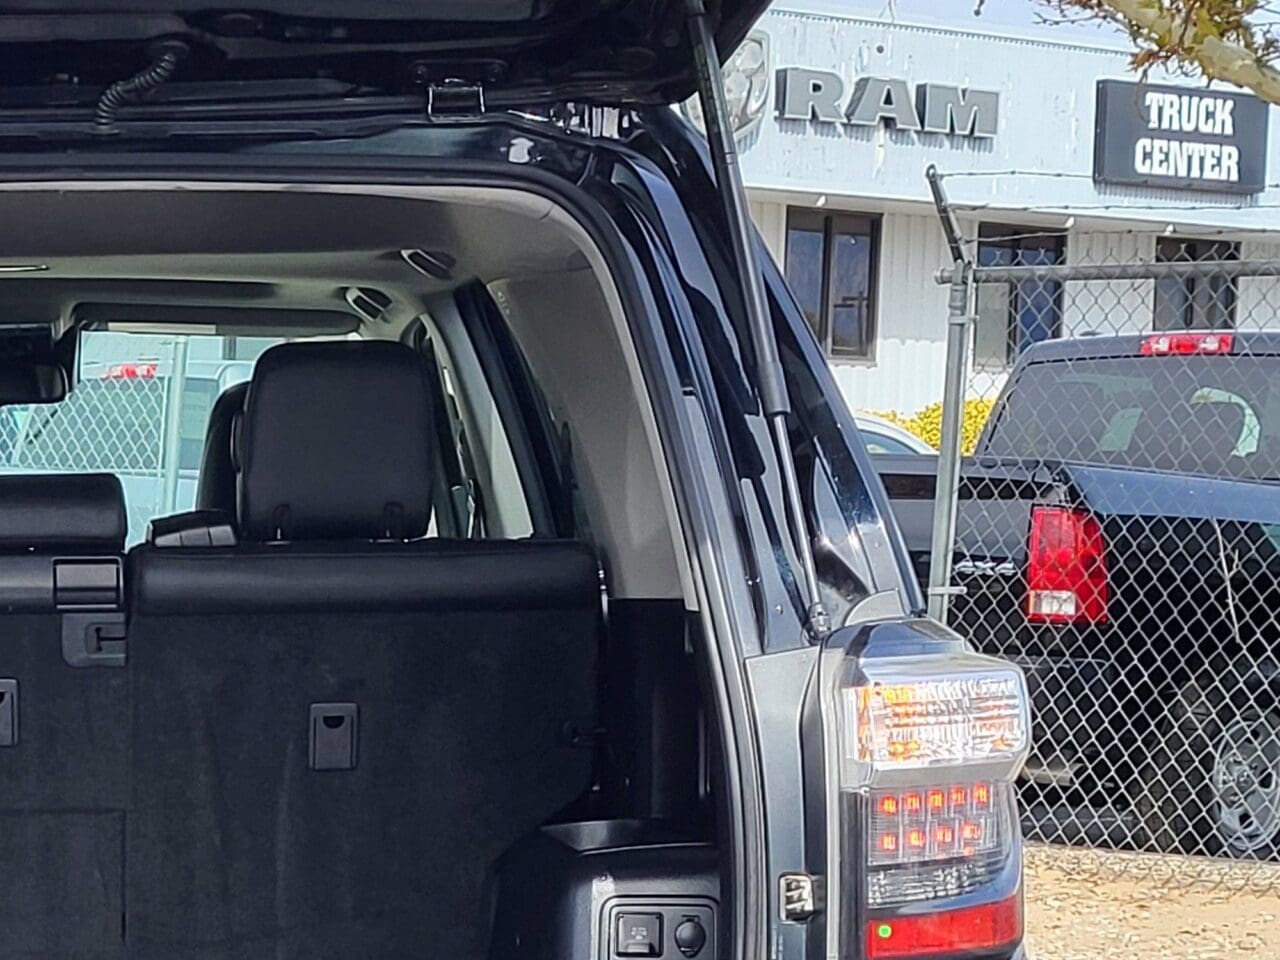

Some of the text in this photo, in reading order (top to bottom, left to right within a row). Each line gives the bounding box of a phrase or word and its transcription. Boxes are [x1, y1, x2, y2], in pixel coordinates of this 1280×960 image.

[775, 67, 999, 137] RAM
[1145, 91, 1234, 135] TRUCK
[1134, 137, 1239, 181] CENTER
